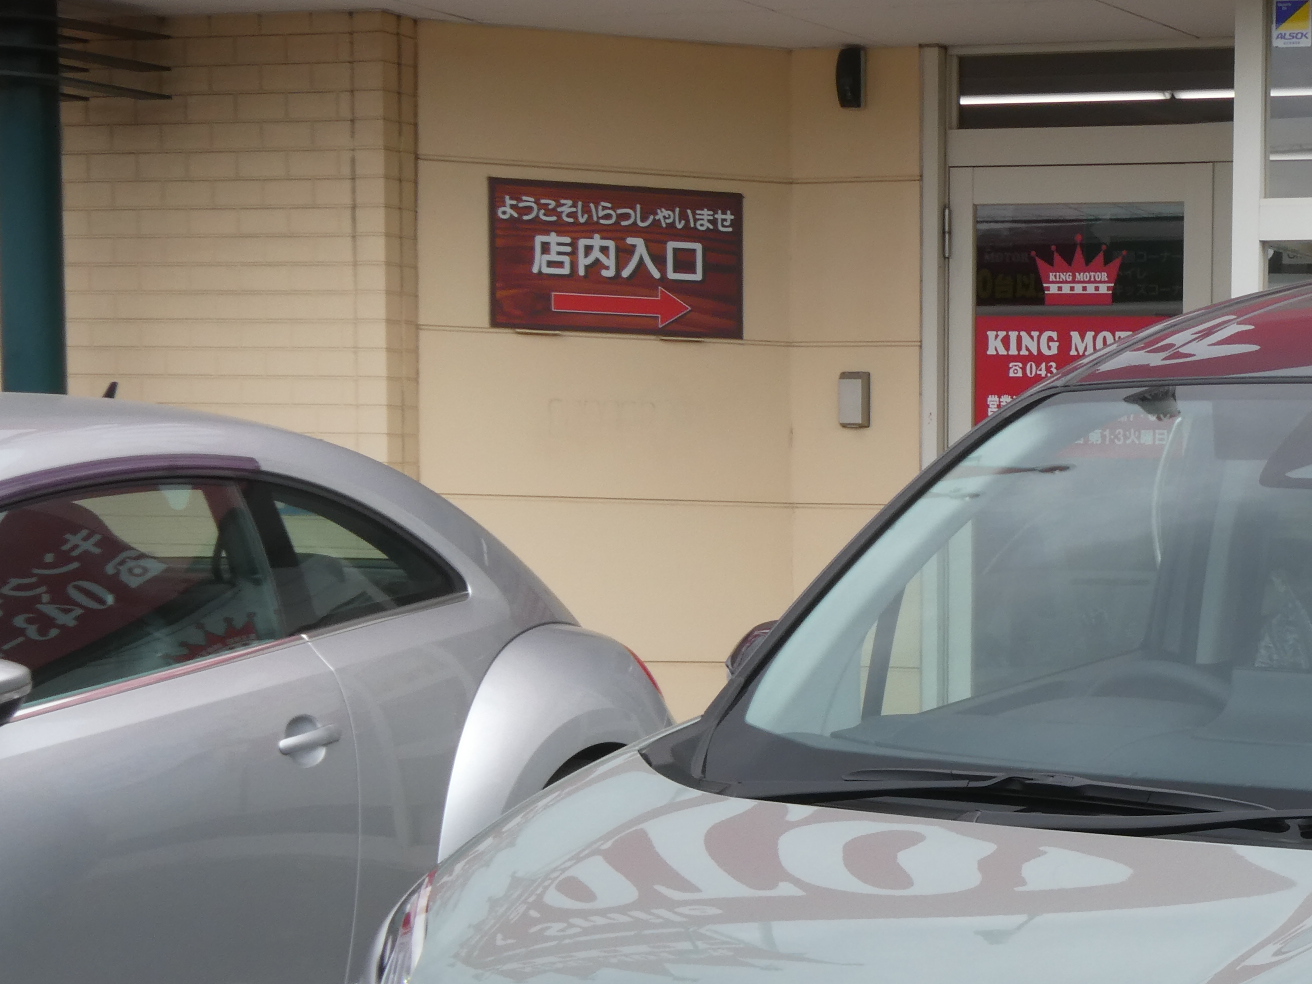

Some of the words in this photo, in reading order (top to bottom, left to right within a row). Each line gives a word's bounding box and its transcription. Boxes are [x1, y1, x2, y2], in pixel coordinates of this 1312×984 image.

[1275, 31, 1309, 41] ALSOK
[498, 195, 735, 232] ようこそいらっしゃいませ
[532, 232, 703, 281] 店内入口
[1049, 272, 1072, 282] KING
[1075, 272, 1109, 282] MOTOR
[987, 331, 1059, 355] KING
